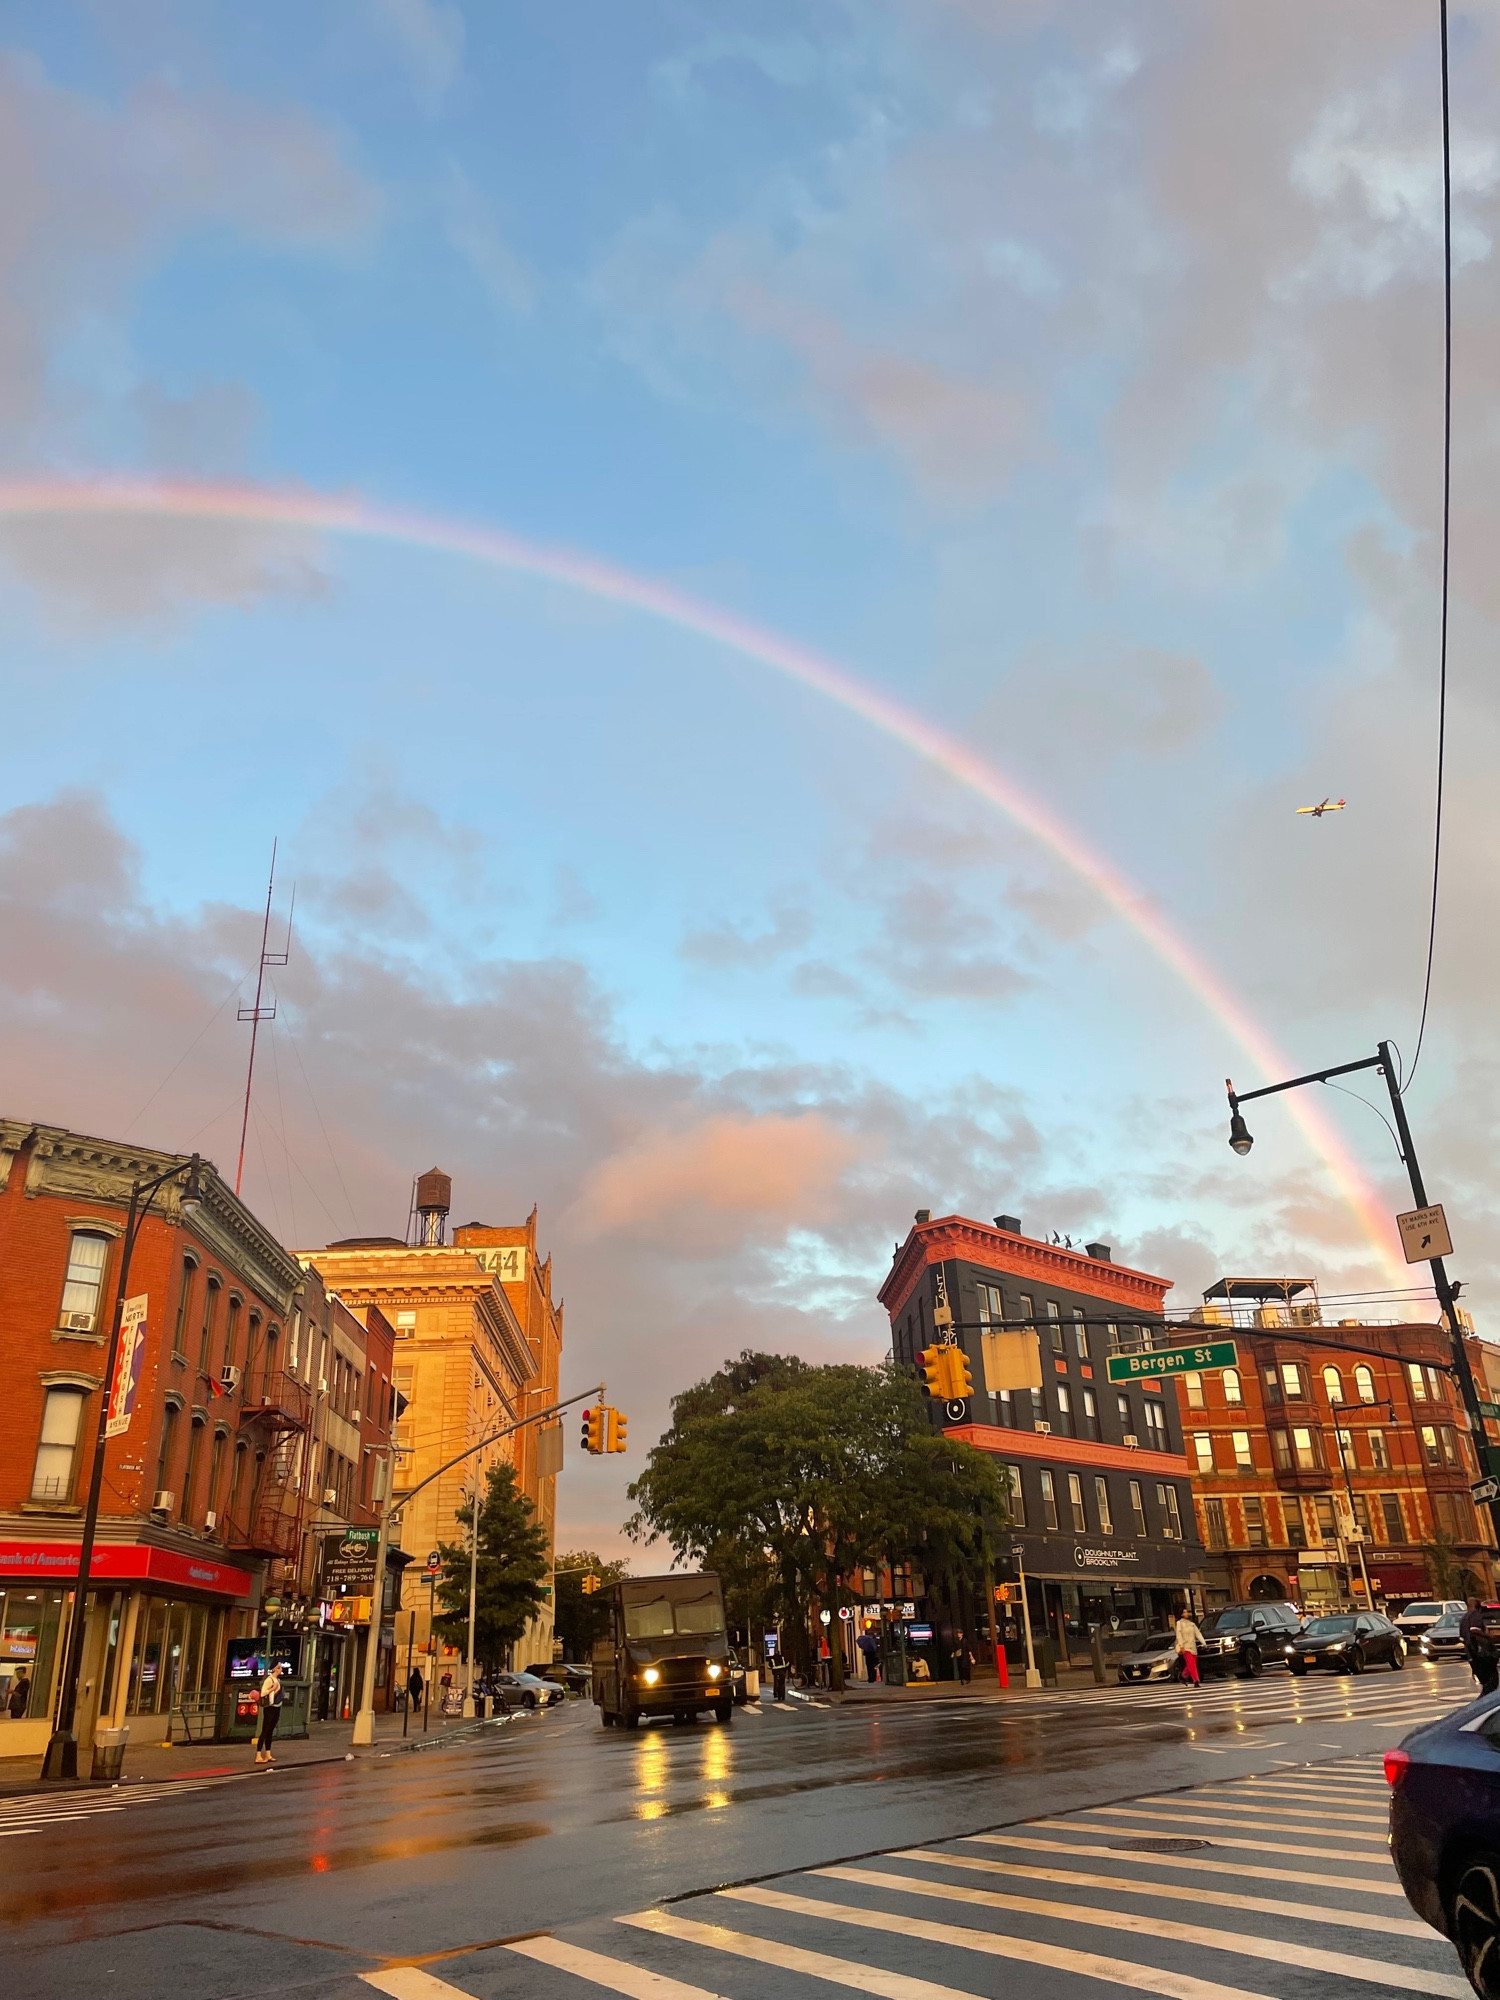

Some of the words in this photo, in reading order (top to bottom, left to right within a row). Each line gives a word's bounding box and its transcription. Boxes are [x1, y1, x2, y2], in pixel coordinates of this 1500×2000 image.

[1410, 1213, 1427, 1222] MARKS
[1406, 1223, 1416, 1231] USE
[125, 1311, 144, 1322] NORTH
[1129, 1353, 1185, 1372] Bergen
[1194, 1348, 1212, 1363] St
[109, 1417, 129, 1429] AVENUE
[349, 1530, 371, 1540] Flatbush
[0, 1552, 22, 1564] ank
[23, 1553, 37, 1565] of
[37, 1553, 80, 1566] Americ
[1084, 1549, 1117, 1558] DOUGHNUT
[1117, 1551, 1137, 1559] PLANT
